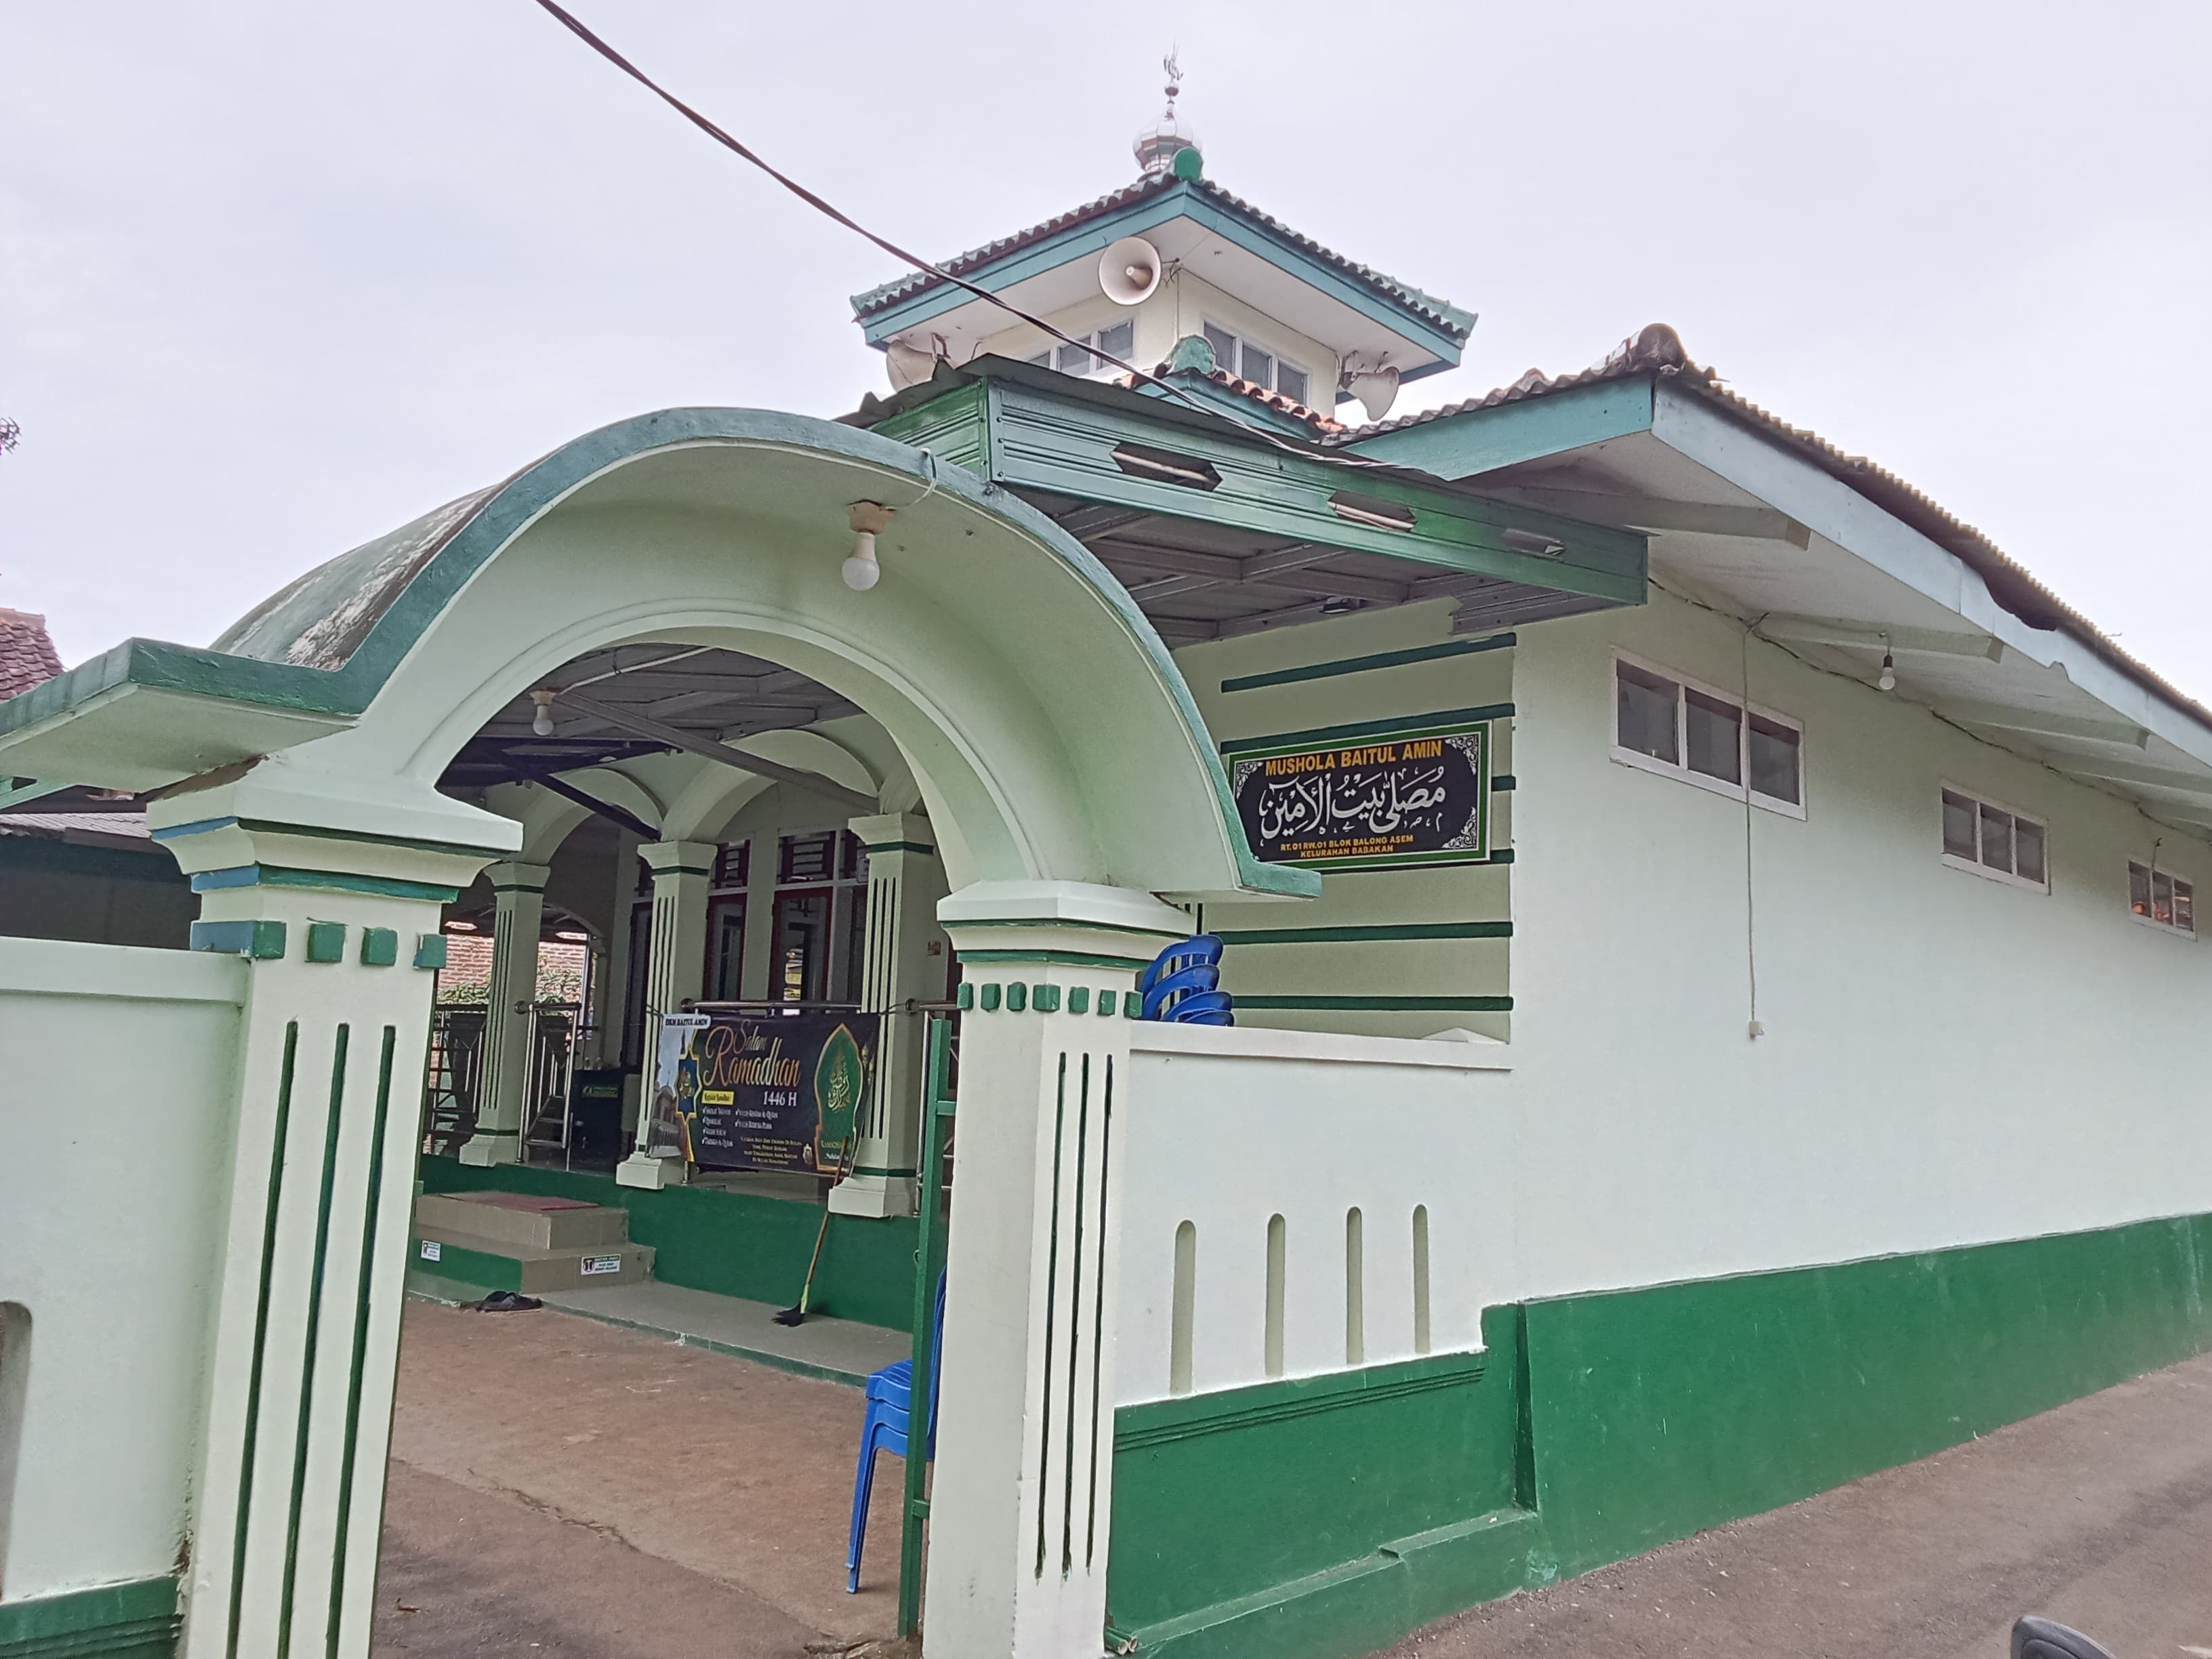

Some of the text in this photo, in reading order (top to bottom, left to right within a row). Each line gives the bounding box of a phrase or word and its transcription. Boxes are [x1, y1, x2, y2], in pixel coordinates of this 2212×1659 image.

[1265, 740, 1442, 776] MUSHOLA BAITUL AMIN
[1300, 845, 1393, 858] KELURAHAN BABAKAN
[1328, 838, 1351, 848] BLOK
[1353, 836, 1388, 846] BALONG
[1389, 834, 1414, 844] ASEM
[733, 1019, 768, 1054] Salam
[703, 1026, 801, 1087] Ramadhan
[763, 1090, 798, 1107] 1446 H
